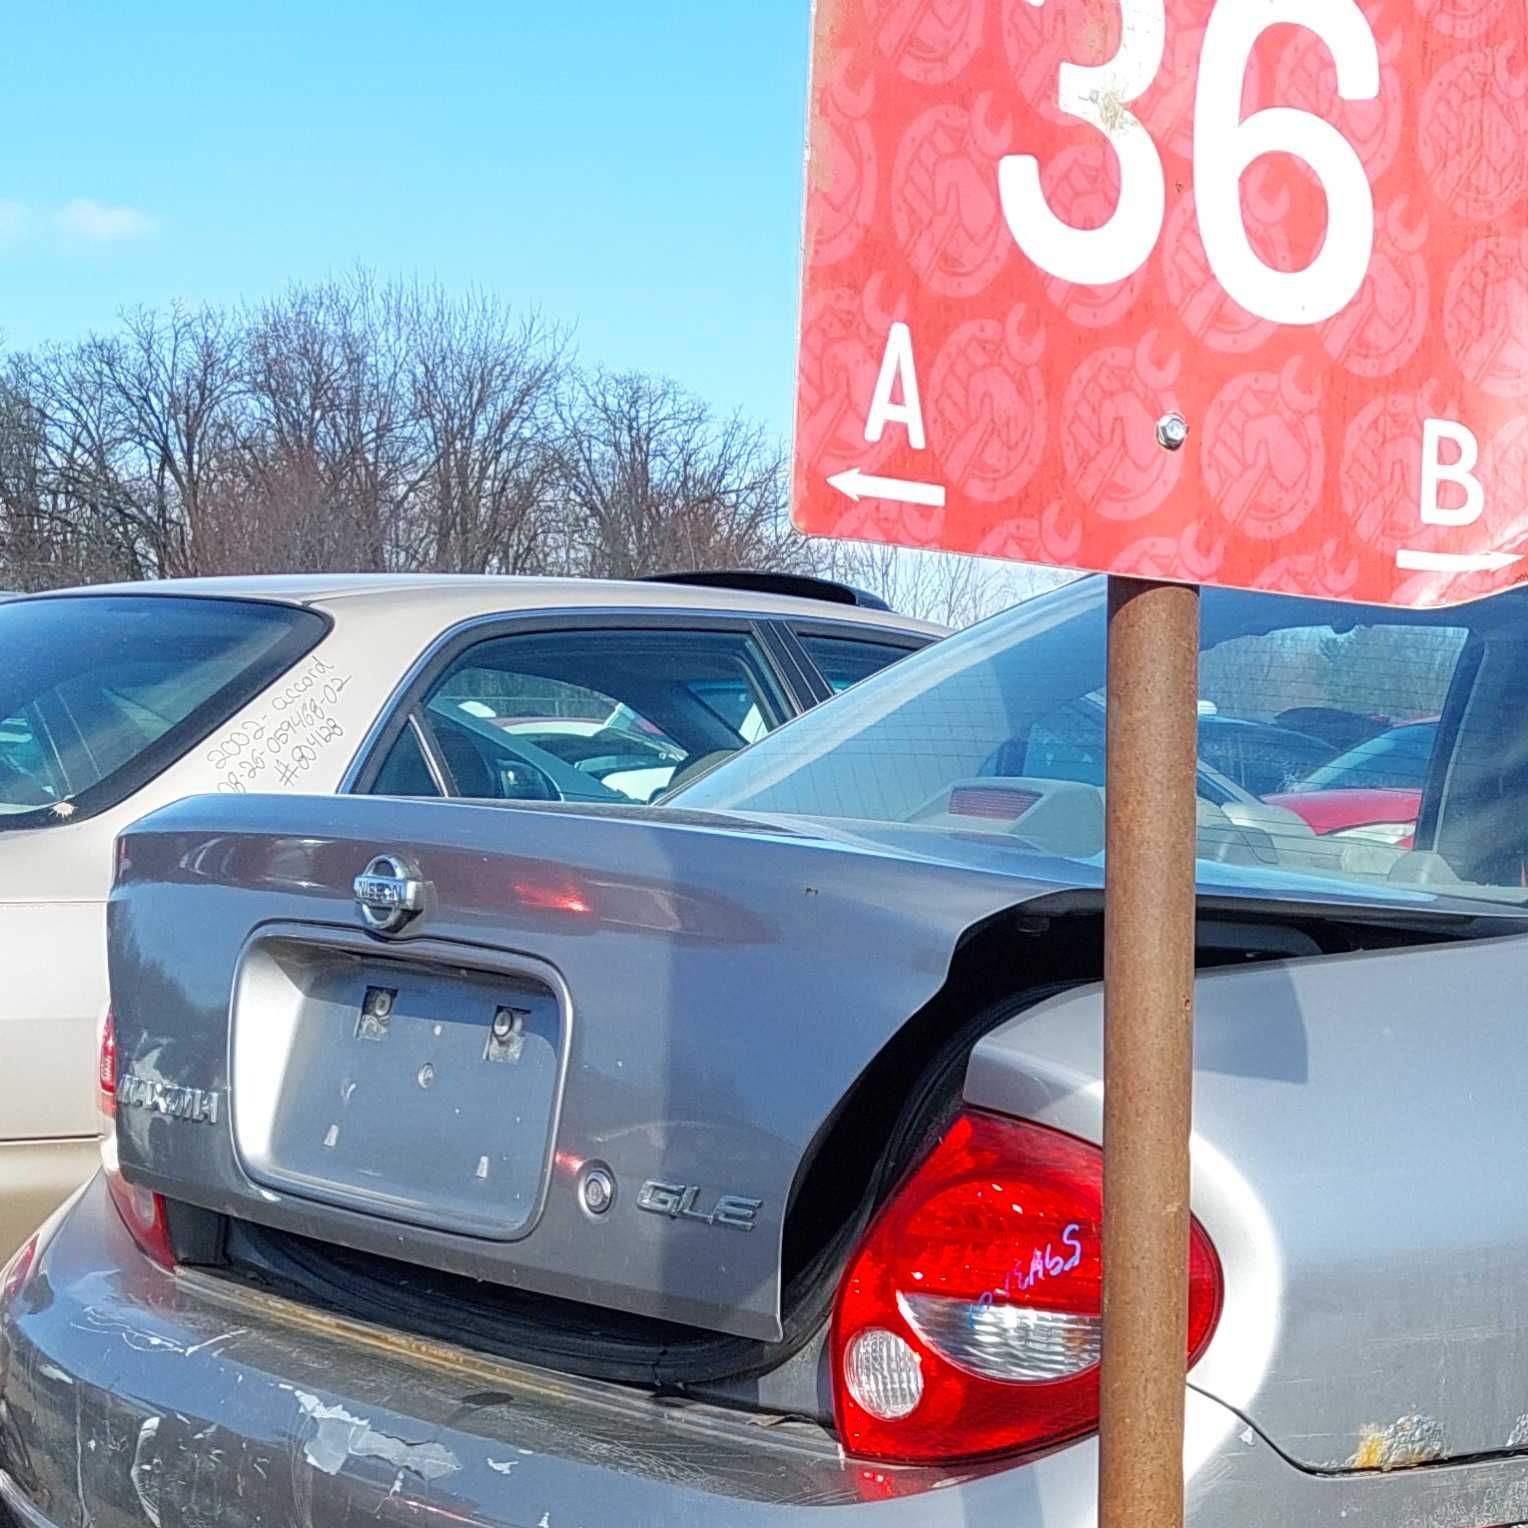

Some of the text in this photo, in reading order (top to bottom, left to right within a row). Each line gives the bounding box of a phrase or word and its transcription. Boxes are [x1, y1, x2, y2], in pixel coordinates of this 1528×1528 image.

[998, 0, 1380, 325] 36
[864, 321, 926, 450] A
[1419, 417, 1485, 527] B
[272, 655, 335, 711] accord
[636, 1179, 763, 1232] GLE
